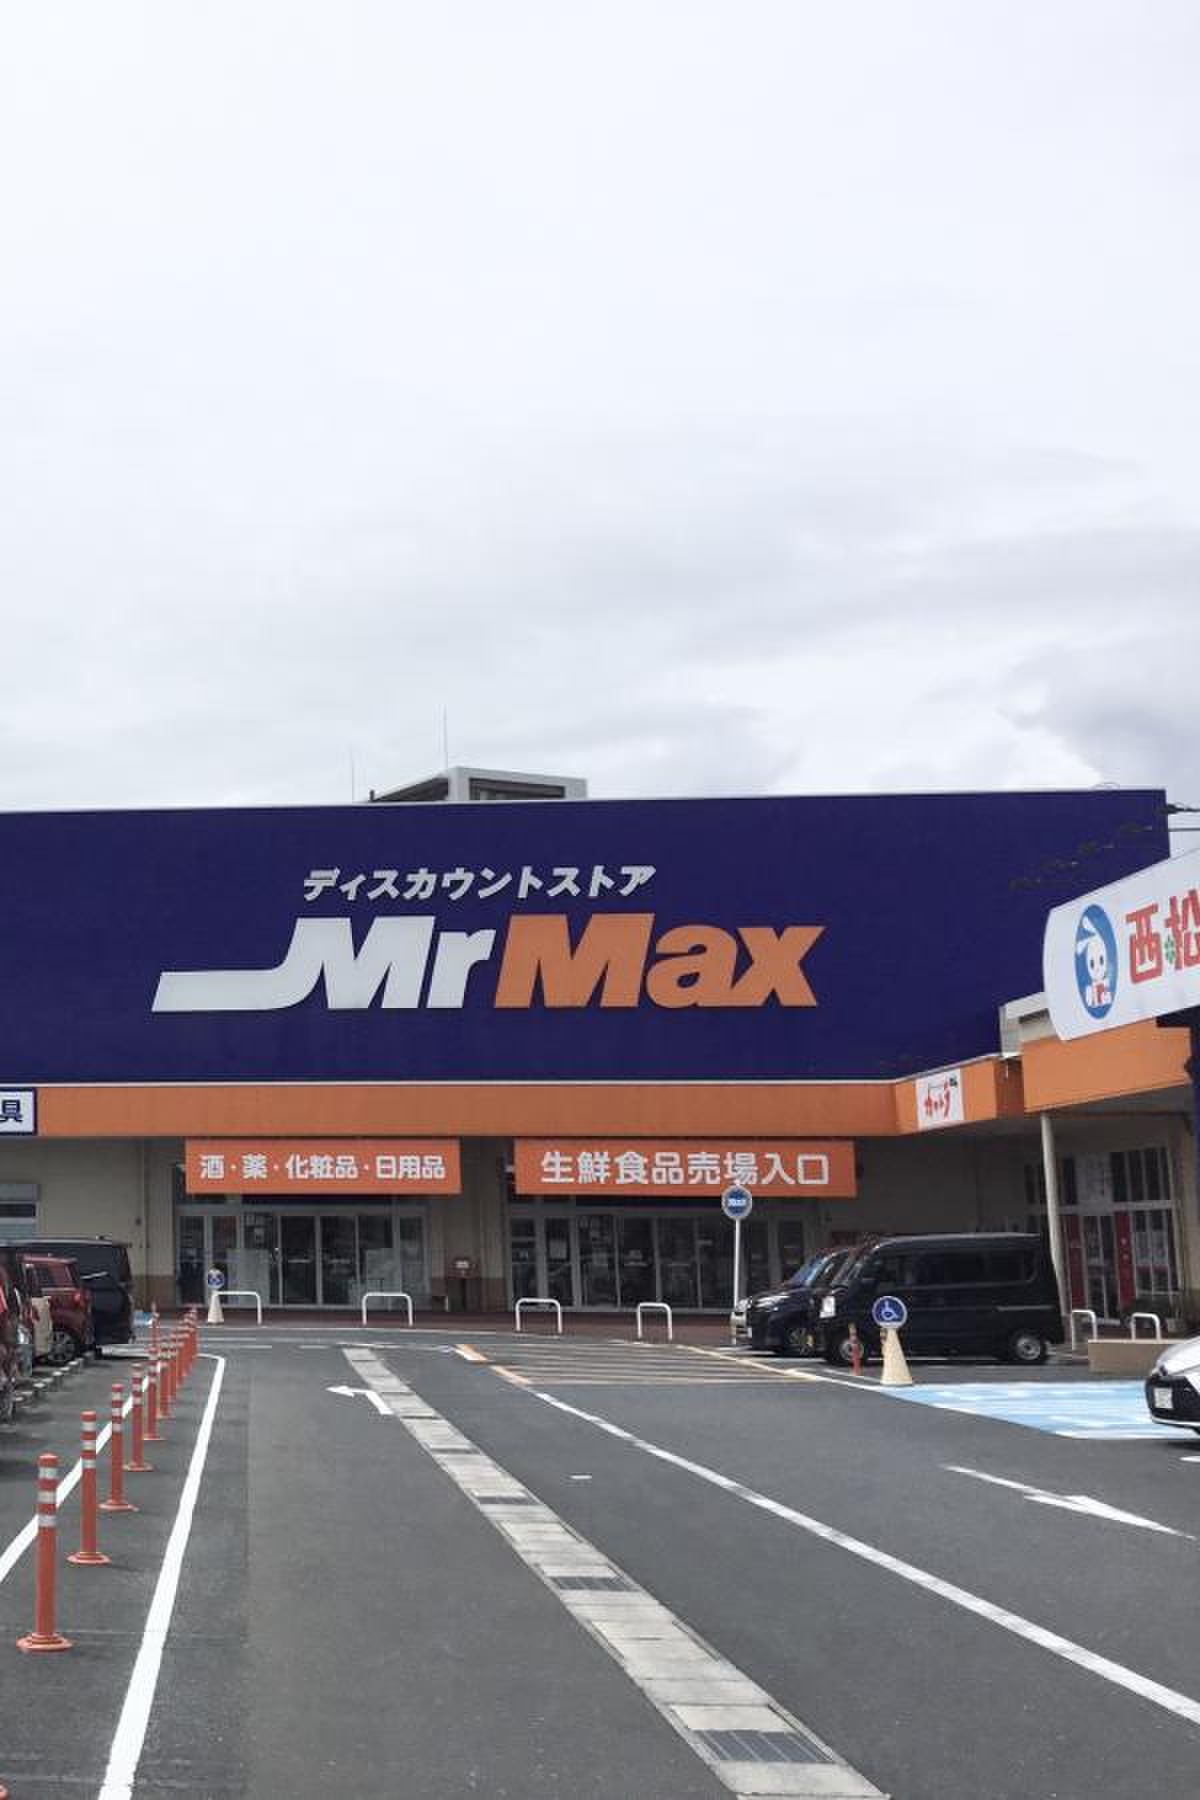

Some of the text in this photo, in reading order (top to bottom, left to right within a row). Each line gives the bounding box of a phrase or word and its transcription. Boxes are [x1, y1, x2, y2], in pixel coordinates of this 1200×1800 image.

[302, 864, 657, 902] ディスカウントストア
[151, 911, 826, 1013] MrMax
[200, 1153, 446, 1181] 酒・薬・化粧品・日用品
[540, 1151, 829, 1186] 生鮮食品売場入口
